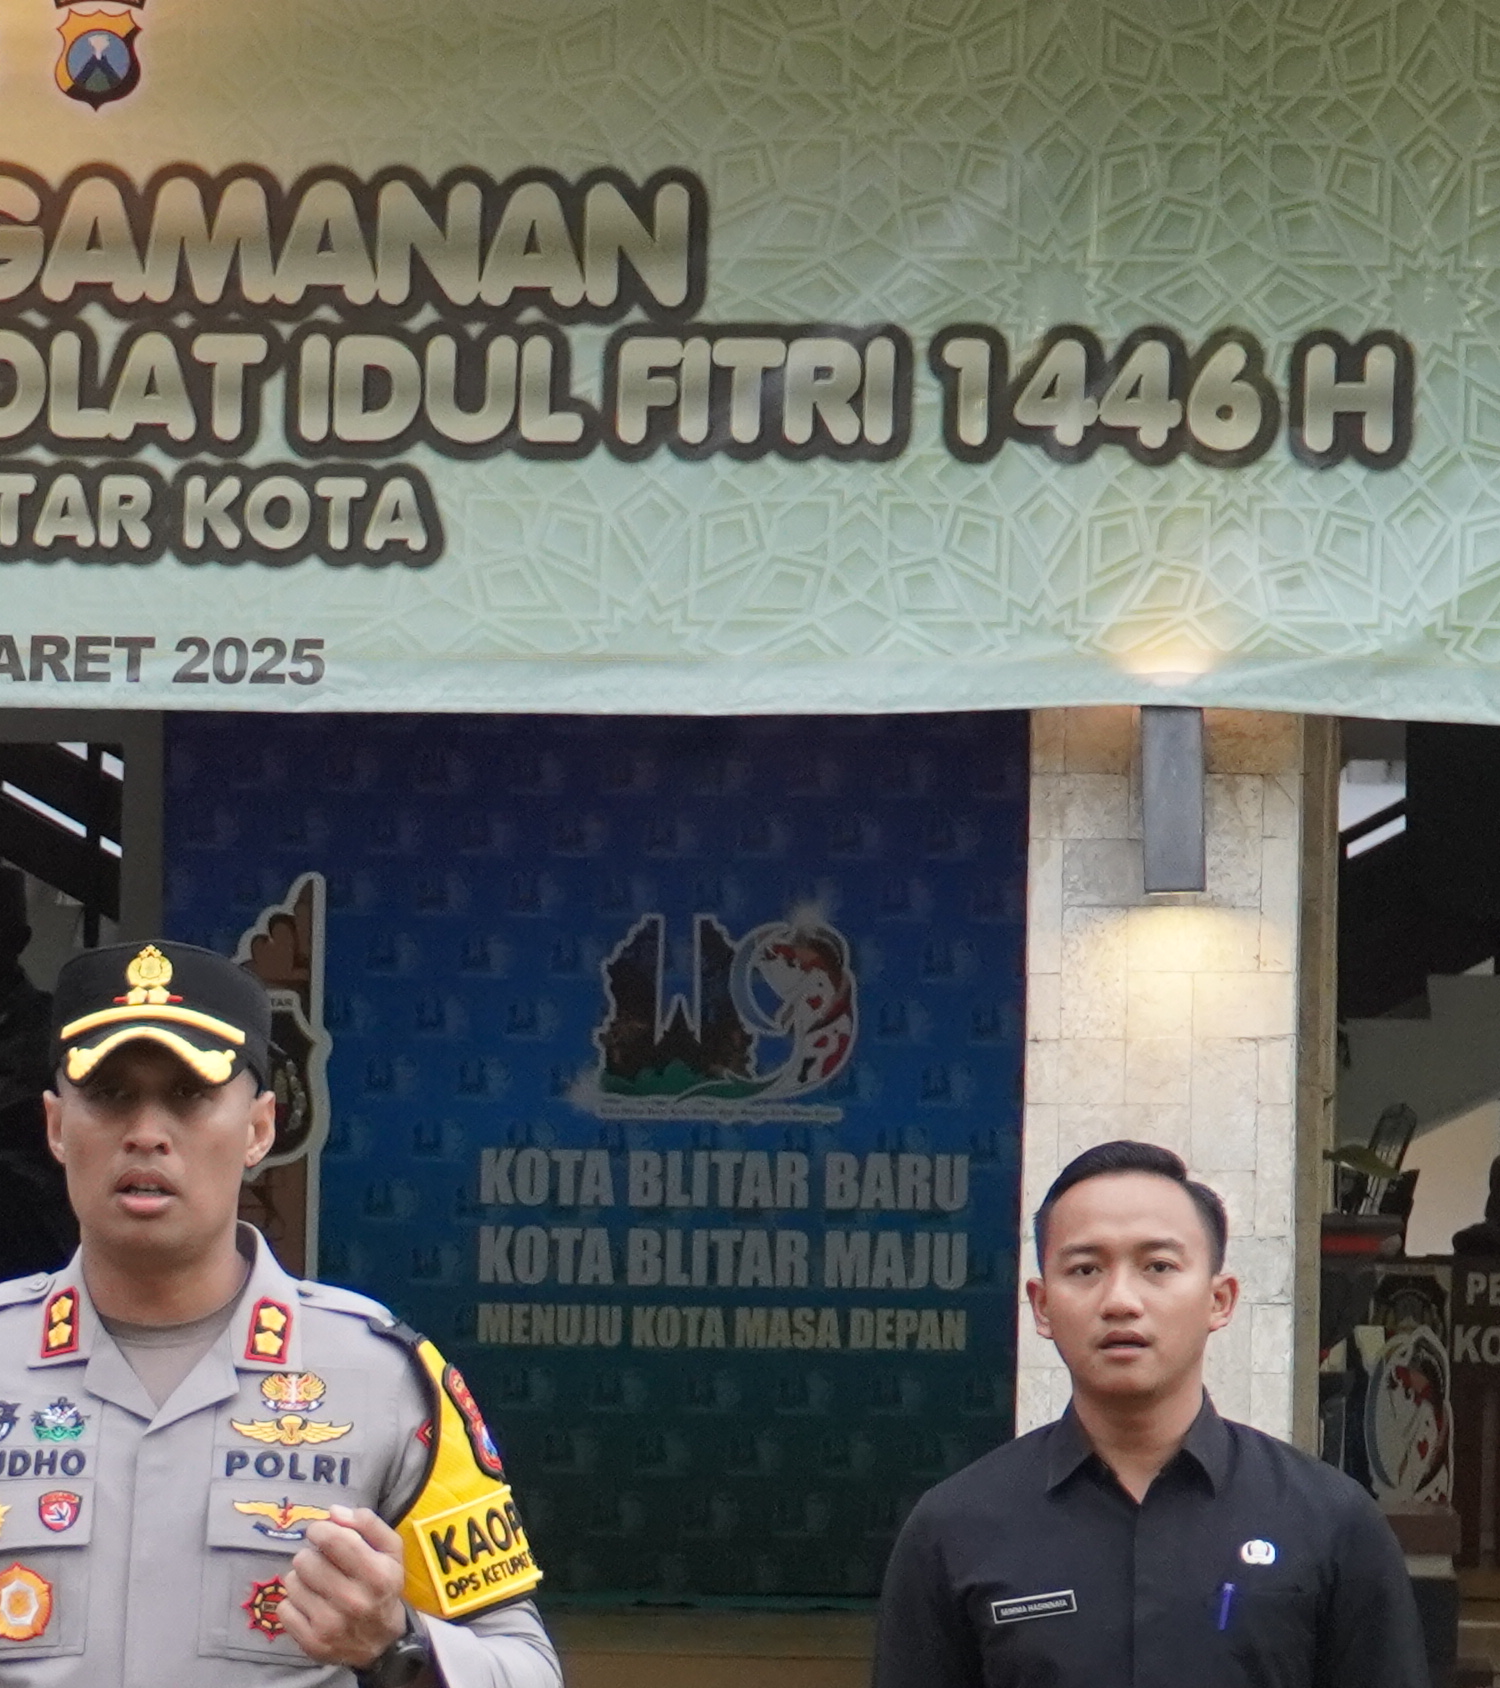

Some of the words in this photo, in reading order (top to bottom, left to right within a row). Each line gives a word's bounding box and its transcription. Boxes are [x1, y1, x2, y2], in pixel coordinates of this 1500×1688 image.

[297, 331, 588, 447] IDUL
[615, 335, 899, 450] FITRI
[940, 335, 1278, 455] 1446
[1299, 345, 1401, 458] H
[180, 475, 430, 553] KOTA
[170, 634, 328, 687] 2025
[479, 1147, 615, 1208] KOTA
[627, 1149, 810, 1210] BLITAR
[824, 1151, 971, 1213] BARU
[477, 1225, 615, 1285] KOTA
[626, 1227, 809, 1288] BLITAR
[823, 1229, 969, 1291] MAJU
[476, 1302, 623, 1348] MENUJU
[631, 1305, 726, 1350] KOTA
[734, 1306, 843, 1351] MASA
[848, 1307, 967, 1352] DEPAN
[225, 1450, 351, 1486] POLRI
[443, 1574, 482, 1601] OPS
